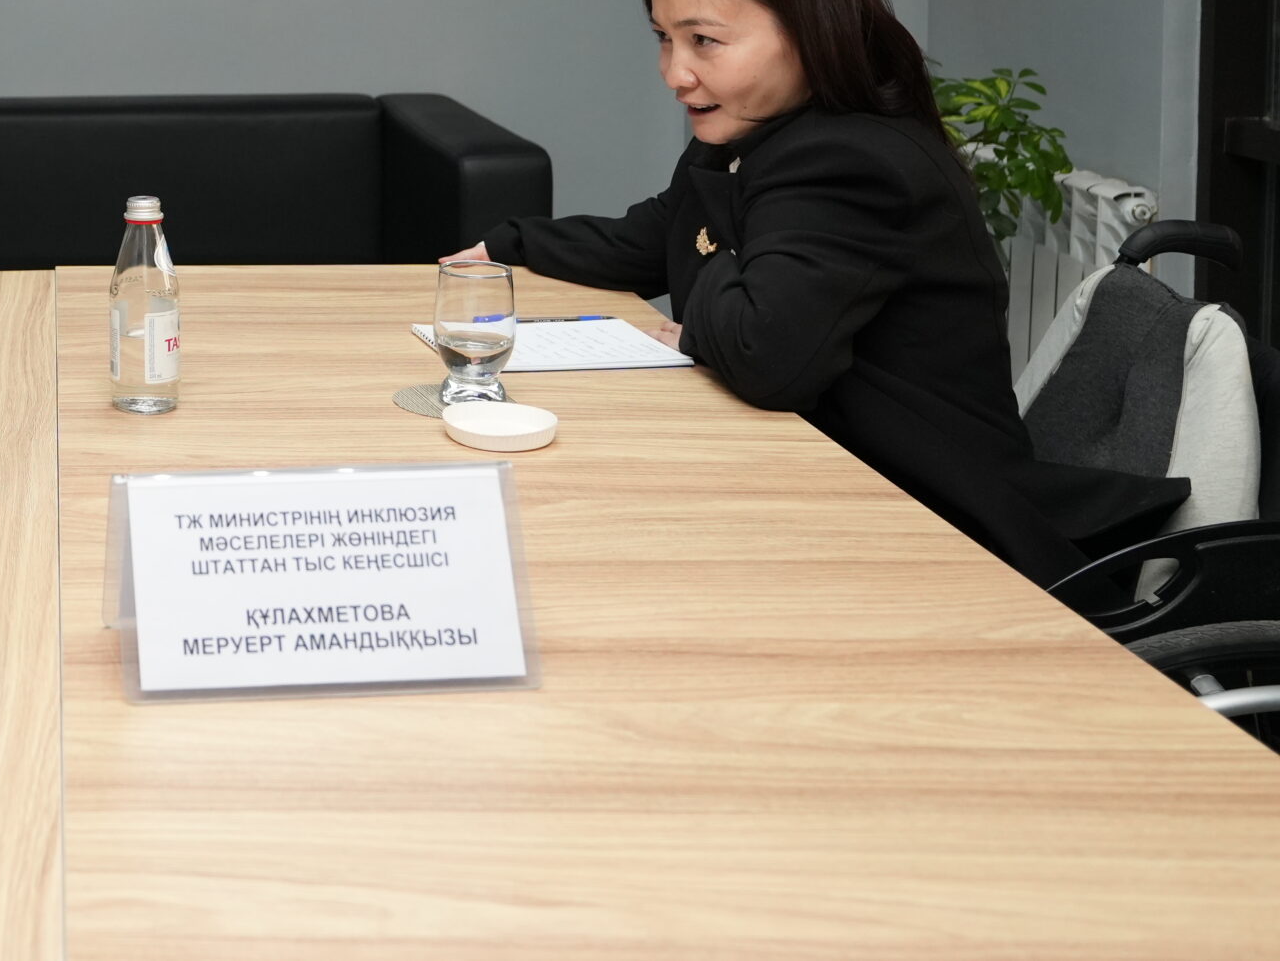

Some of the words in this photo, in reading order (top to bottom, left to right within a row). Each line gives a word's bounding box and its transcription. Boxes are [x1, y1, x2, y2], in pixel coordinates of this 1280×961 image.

[175, 514, 203, 529] ТЖ
[209, 511, 342, 528] МИНИСТРІНІҢ
[347, 506, 457, 524] ИНКЛЮЗИЯ
[199, 534, 325, 552] МӘСЕЛЕЛЕРІ
[332, 529, 437, 548] ЖӨНІНДЕГІ
[192, 558, 287, 576] ШТАТТАН
[294, 556, 336, 572] ТЫС
[342, 552, 449, 572] КЕҢЕСШІСІ
[246, 604, 411, 628] ҚҰЛАХМЕТОВА
[183, 635, 286, 656] МЕРУЕРТ
[294, 627, 478, 652] АМАНДЫҚҚЫЗЫ
